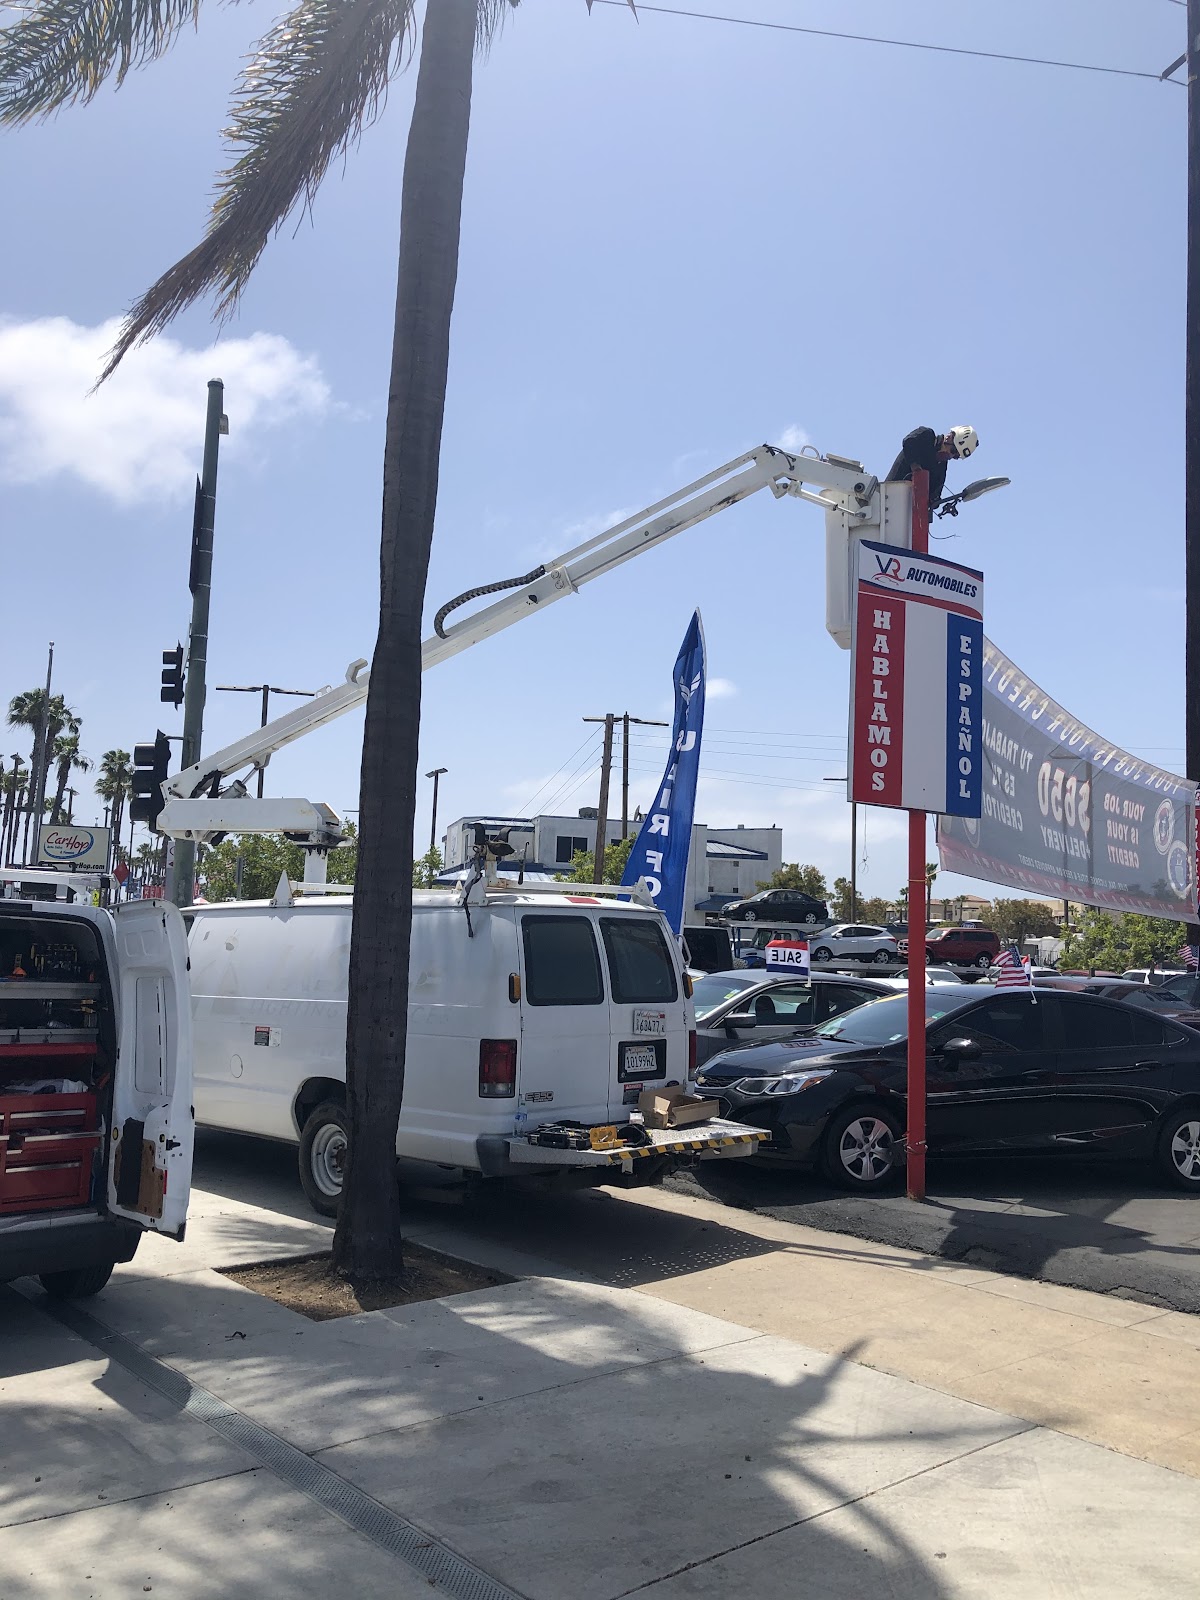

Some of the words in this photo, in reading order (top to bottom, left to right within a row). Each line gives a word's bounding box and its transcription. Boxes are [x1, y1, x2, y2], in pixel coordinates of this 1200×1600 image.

[906, 567, 978, 599] AUTOMOBILES
[867, 609, 891, 791] HABLAMOS
[958, 635, 972, 799] ESPAÑOL
[46, 831, 89, 853] CarHop
